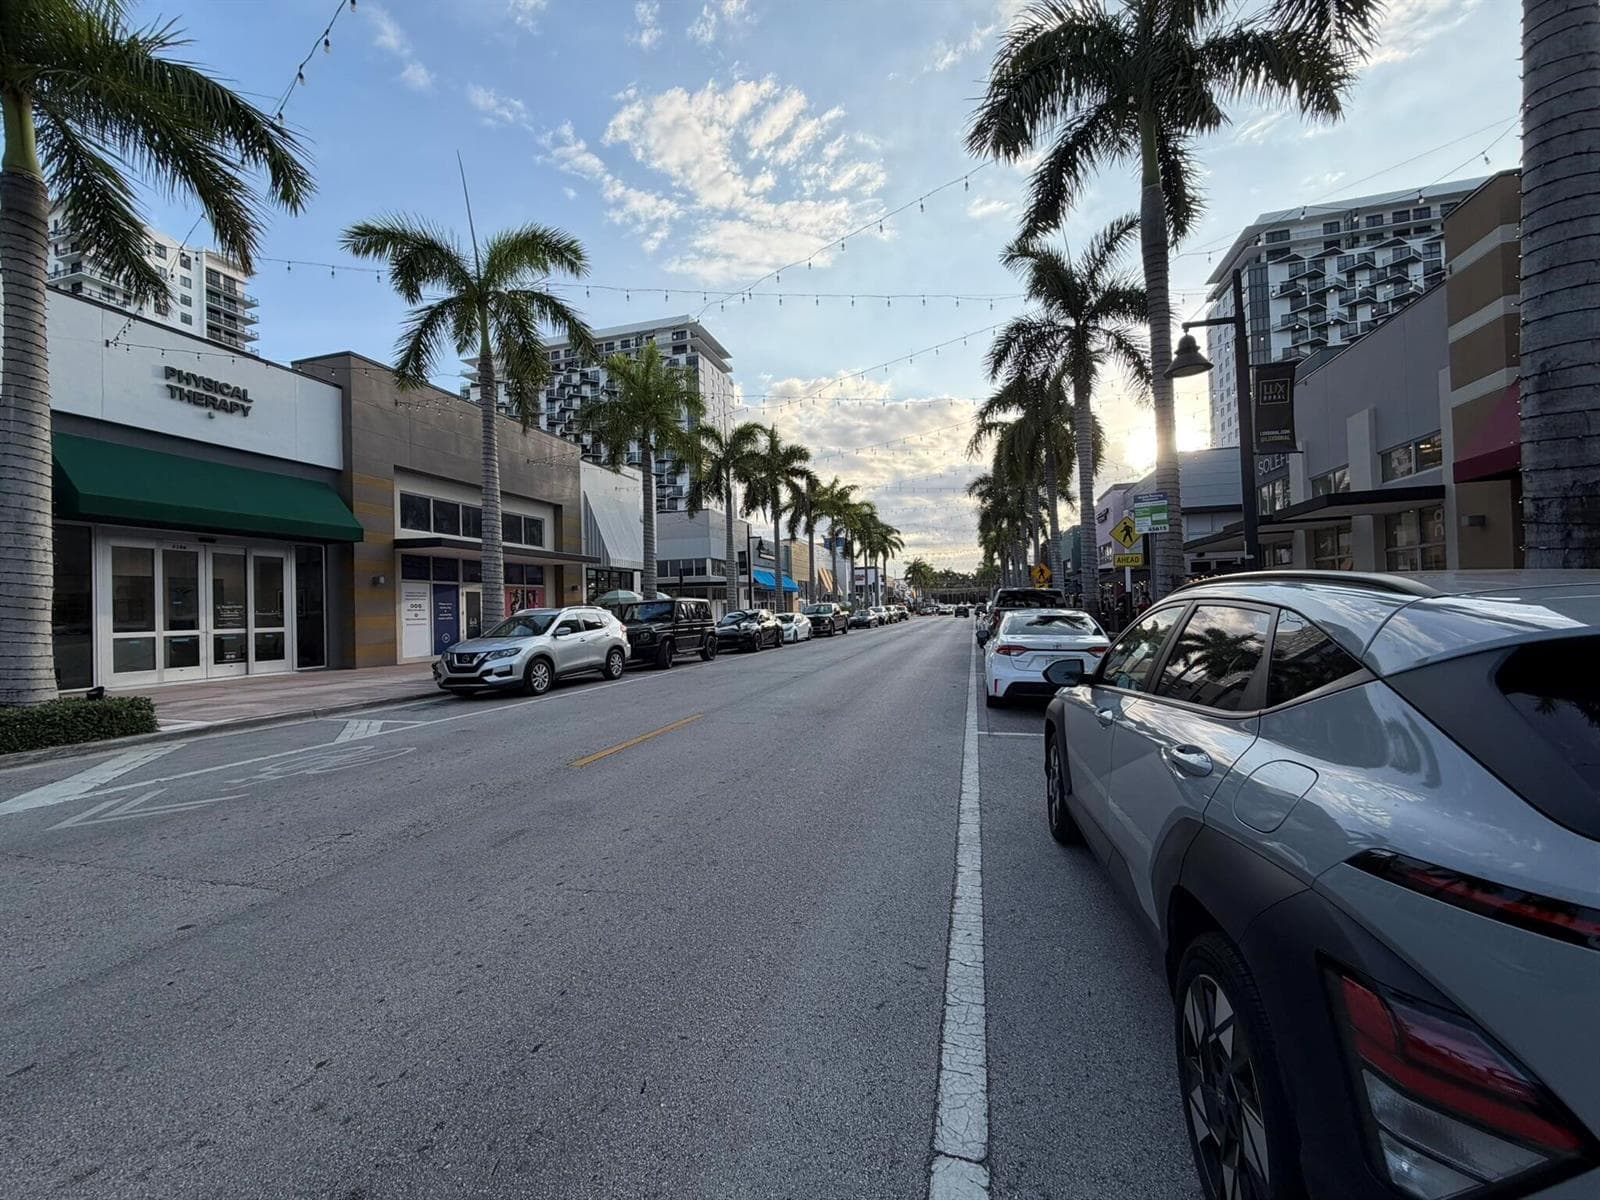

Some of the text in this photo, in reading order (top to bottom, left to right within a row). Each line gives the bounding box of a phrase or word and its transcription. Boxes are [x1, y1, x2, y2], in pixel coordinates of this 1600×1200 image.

[164, 365, 254, 403] PHYSICAL
[1263, 382, 1286, 395] LUX
[165, 383, 252, 417] THERAPY
[1117, 556, 1139, 564] AHEAD
